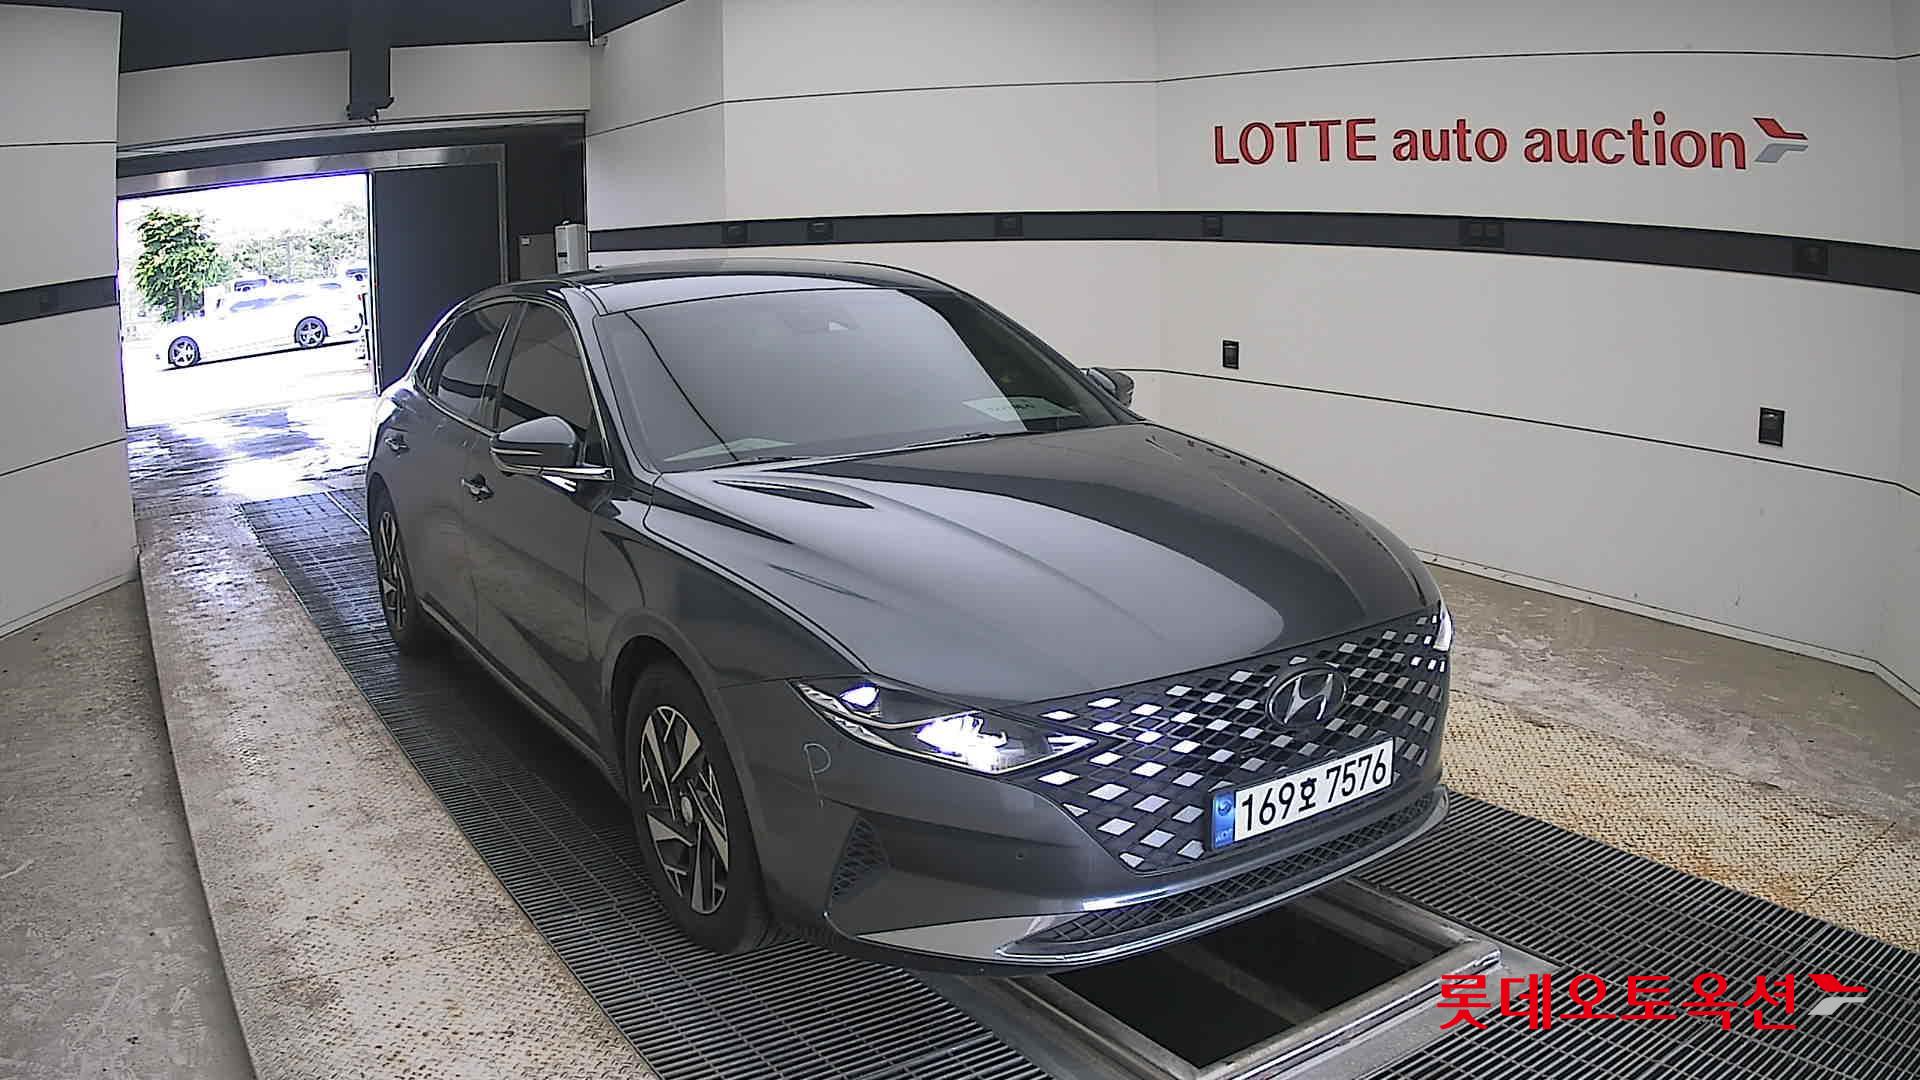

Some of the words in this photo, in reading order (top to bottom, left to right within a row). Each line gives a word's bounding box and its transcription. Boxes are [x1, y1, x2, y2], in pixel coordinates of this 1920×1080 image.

[1214, 118, 1377, 165] LOTTE
[1392, 119, 1507, 163] auto
[1523, 111, 1746, 170] auction
[1241, 777, 1318, 832] 169호
[1326, 748, 1387, 803] 7576
